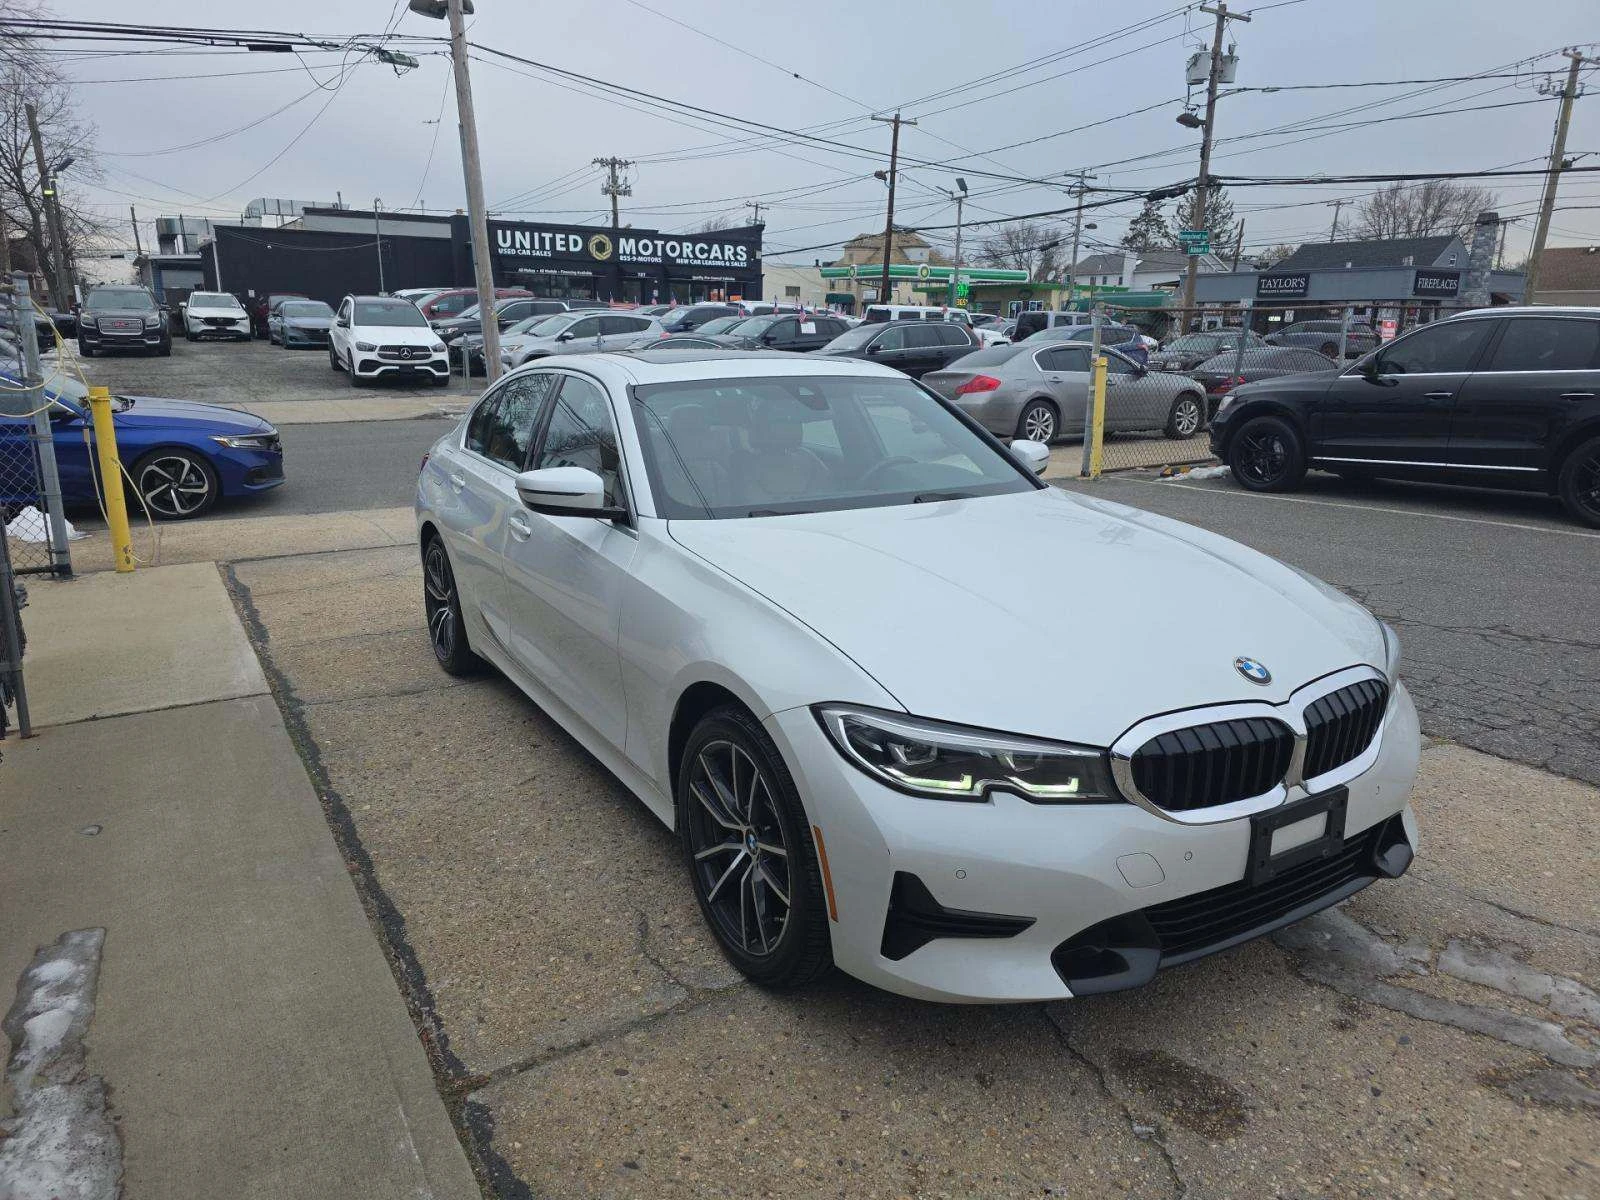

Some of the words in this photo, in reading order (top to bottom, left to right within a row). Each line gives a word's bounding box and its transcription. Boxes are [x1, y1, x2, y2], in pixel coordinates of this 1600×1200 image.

[497, 230, 583, 252] UNITED
[619, 238, 747, 261] MOTORCARS
[1261, 278, 1306, 289] TAYLOR'S
[1418, 277, 1458, 289] FIREPLACES
